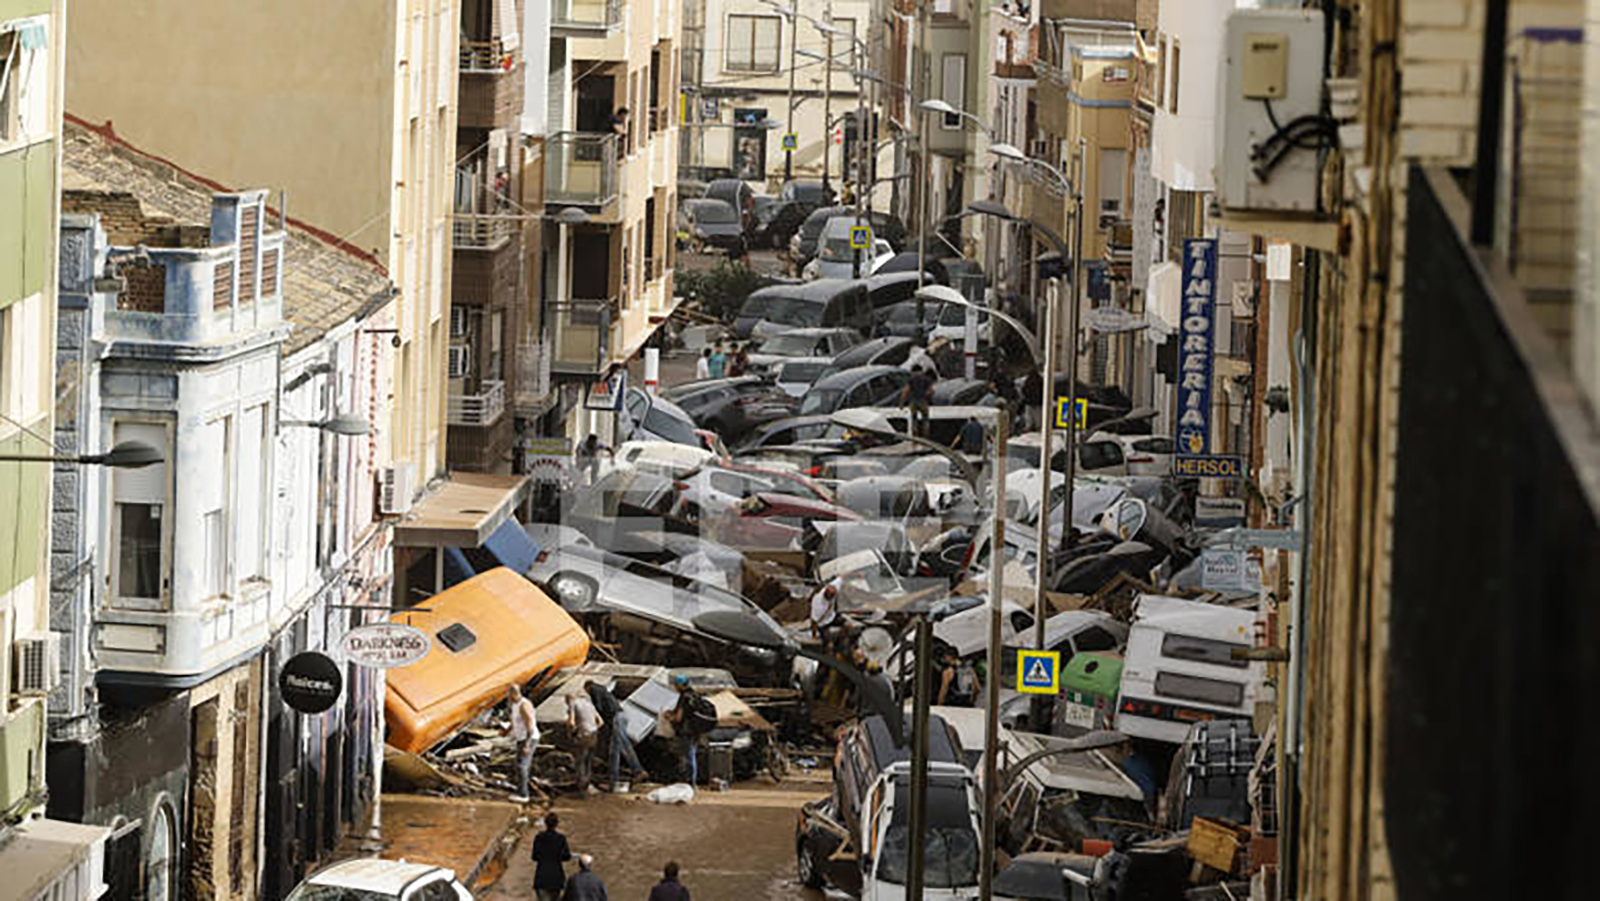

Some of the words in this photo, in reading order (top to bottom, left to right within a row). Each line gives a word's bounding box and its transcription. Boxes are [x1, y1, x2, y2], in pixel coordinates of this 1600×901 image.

[1182, 242, 1211, 425] TINTORERIA
[1177, 459, 1240, 475] HERSOL
[350, 637, 420, 650] DARKNESS
